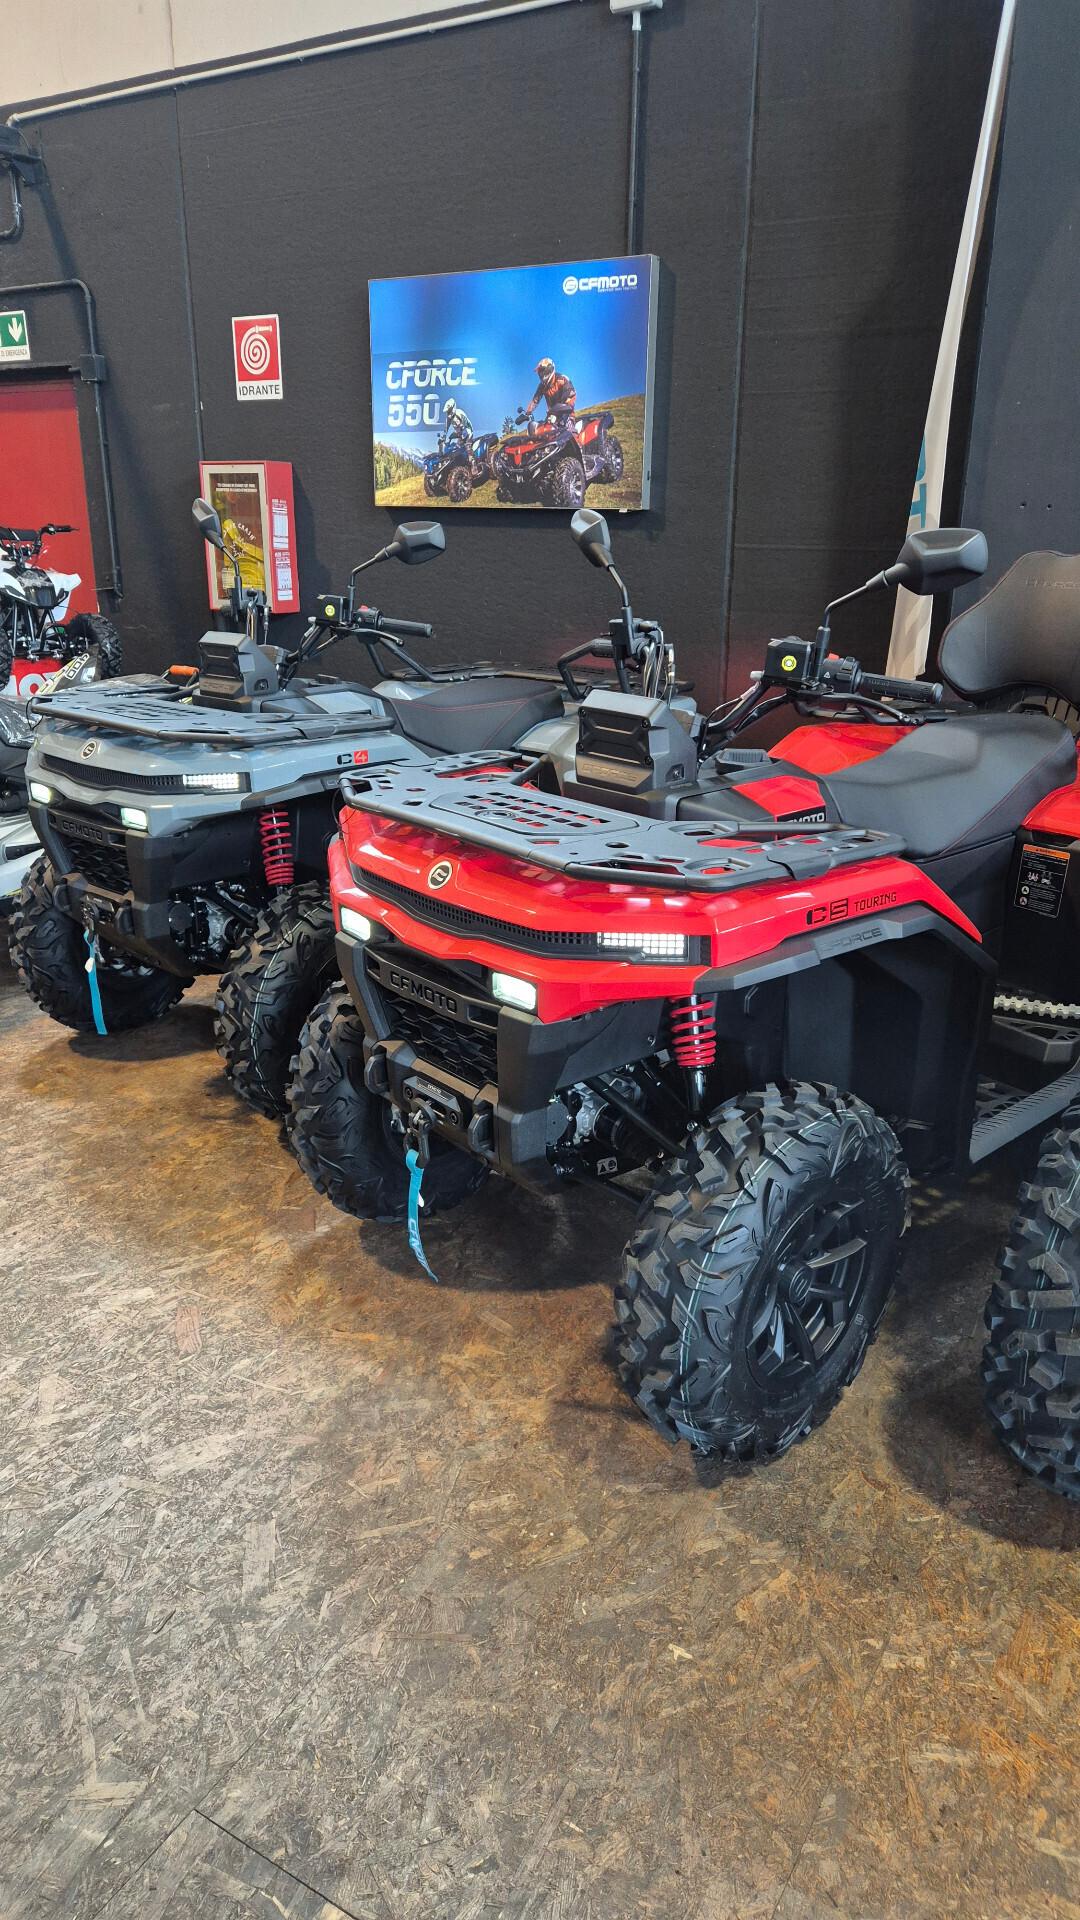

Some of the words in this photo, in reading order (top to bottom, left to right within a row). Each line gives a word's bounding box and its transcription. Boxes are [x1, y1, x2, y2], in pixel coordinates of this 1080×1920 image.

[579, 275, 638, 291] CFMOTO
[386, 358, 479, 390] CFORCE
[239, 385, 281, 396] IDRANTE
[388, 394, 441, 427] 550
[337, 749, 369, 765] C4
[786, 812, 825, 823] OTO
[63, 821, 103, 841] CFMOTO
[854, 892, 897, 912] TOURING
[391, 971, 457, 1014] CFMOTO
